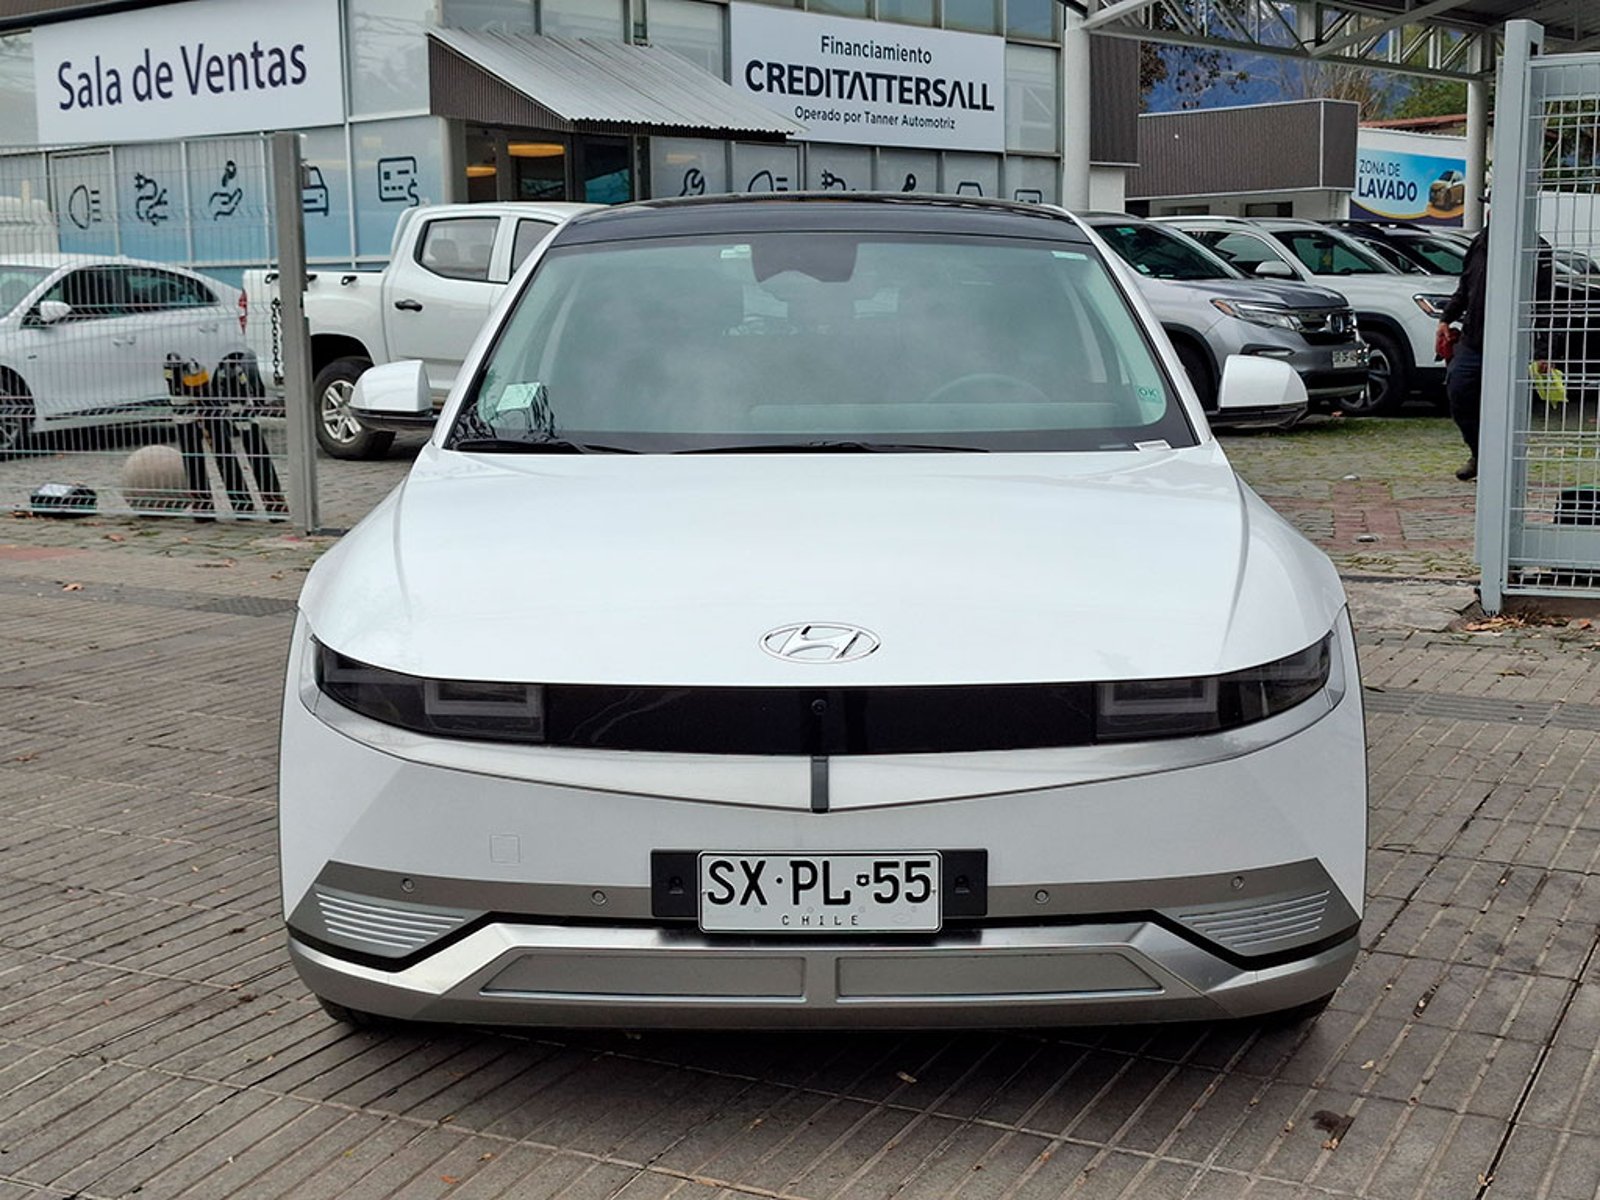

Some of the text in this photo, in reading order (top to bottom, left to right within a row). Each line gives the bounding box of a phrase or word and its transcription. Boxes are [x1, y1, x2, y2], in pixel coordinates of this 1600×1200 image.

[821, 35, 932, 64] Financiamiento
[57, 40, 307, 111] Sala de Ventas
[745, 59, 995, 111] CREDITATTERSALL
[795, 105, 955, 130] Operado por Tanner Automotriz
[1360, 159, 1401, 177] ZONA DE
[1359, 177, 1418, 202] LAVADO
[781, 915, 859, 926] CHILE
